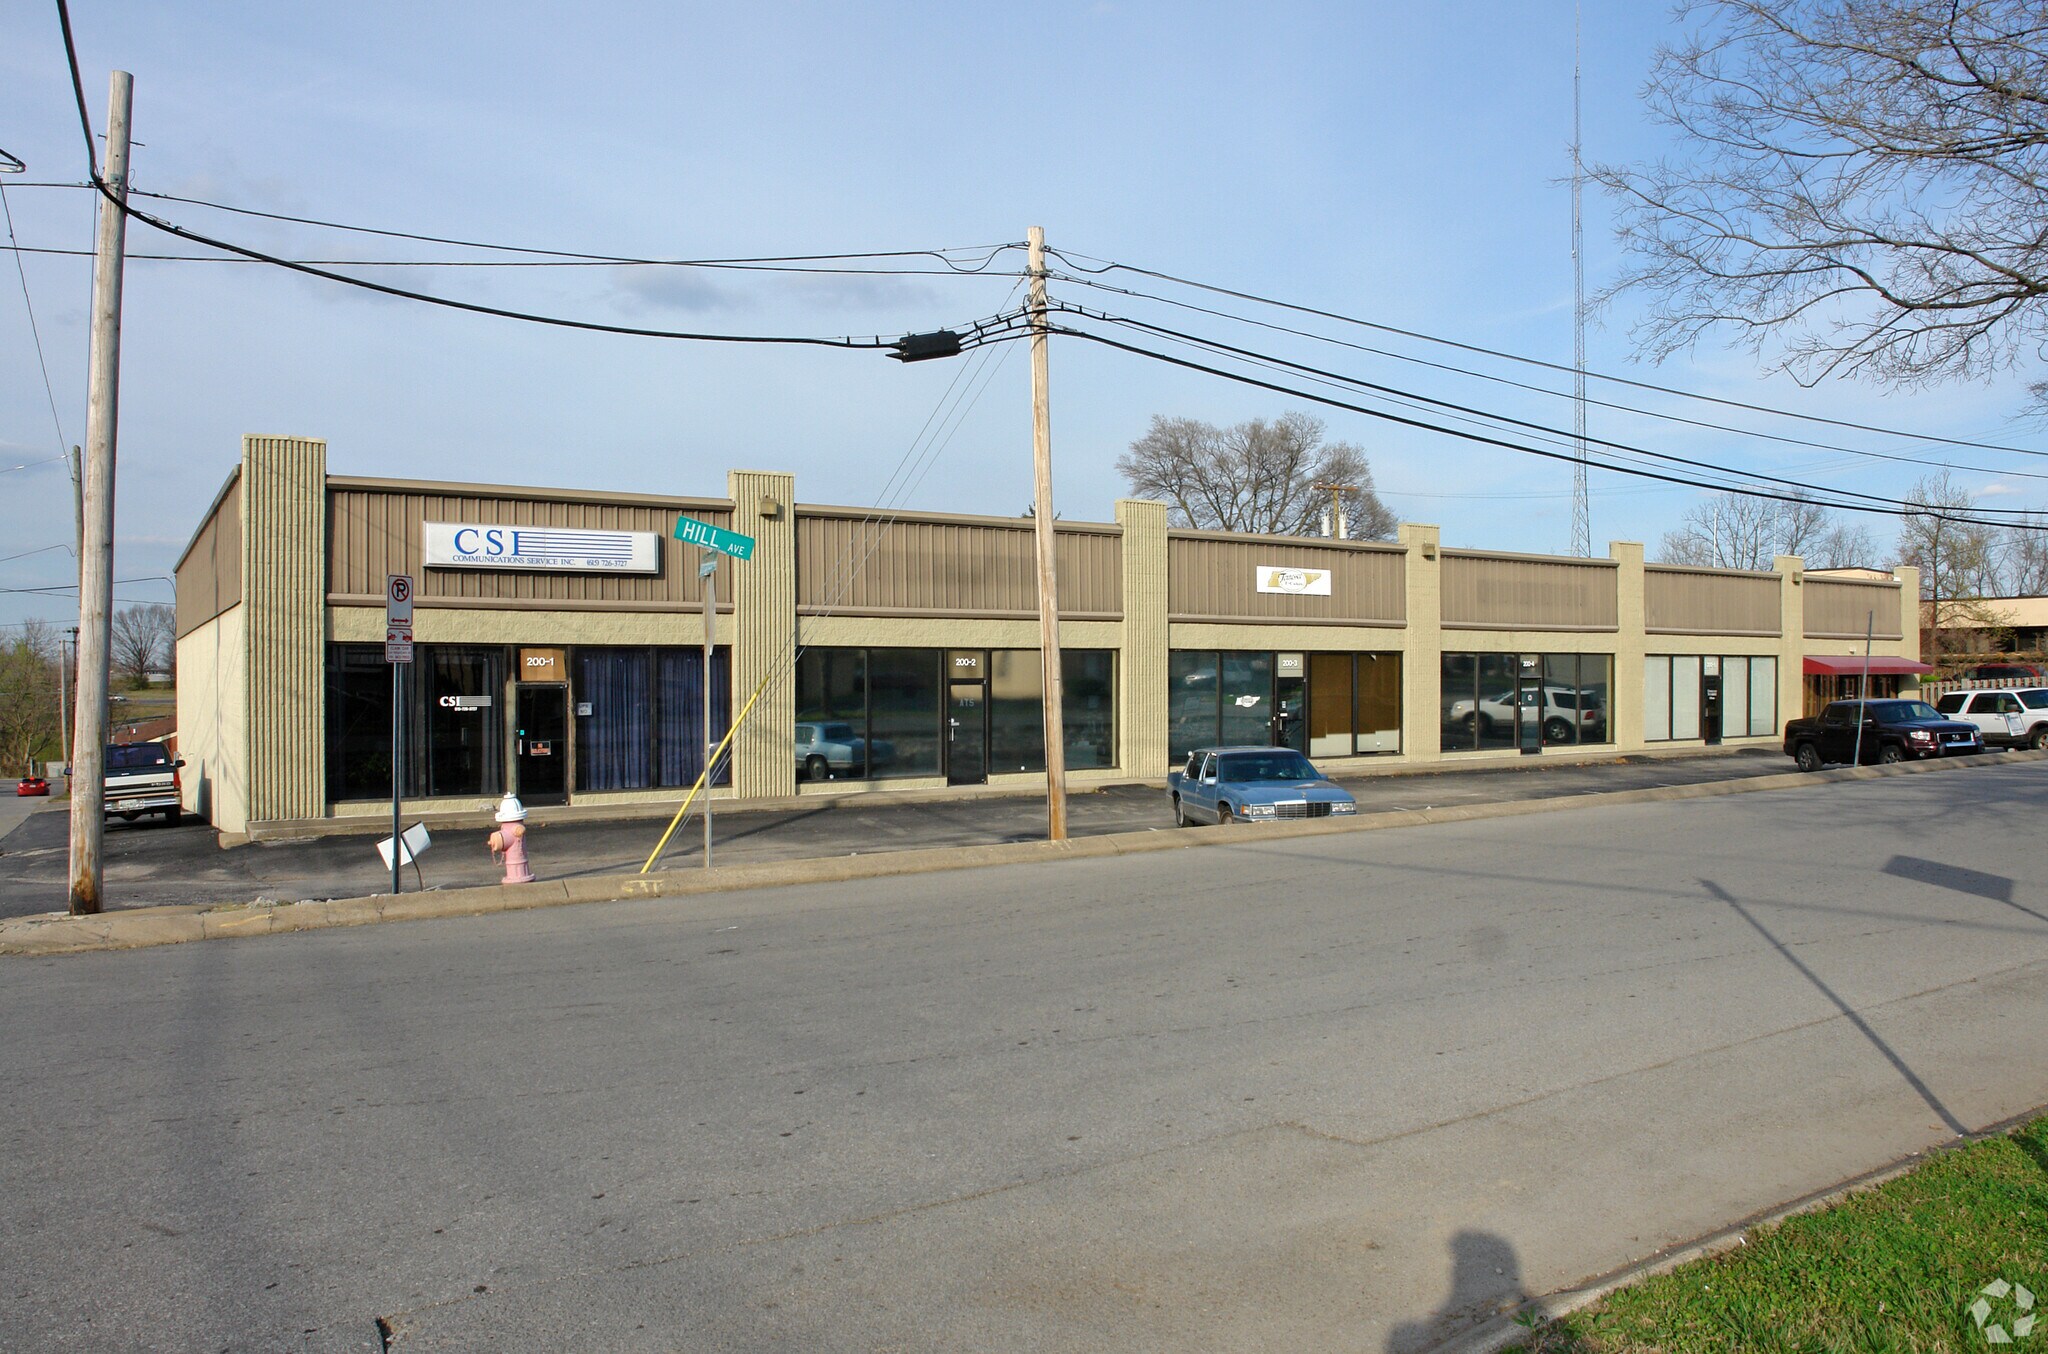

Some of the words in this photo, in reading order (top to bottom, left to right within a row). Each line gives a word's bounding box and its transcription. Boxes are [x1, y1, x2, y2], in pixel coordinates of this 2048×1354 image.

[454, 528, 520, 556] CSI
[682, 521, 719, 548] HILL
[727, 543, 745, 556] AVE
[452, 555, 525, 564] COMMUNICATIONS
[526, 557, 558, 565] SERVICE
[561, 558, 576, 566] INC.
[601, 559, 628, 567] 726-3727
[526, 657, 555, 667] 200-1
[955, 658, 977, 667] 200-2
[1282, 659, 1298, 667] 200-3
[439, 695, 460, 707] CSI
[959, 697, 975, 707] ATS
